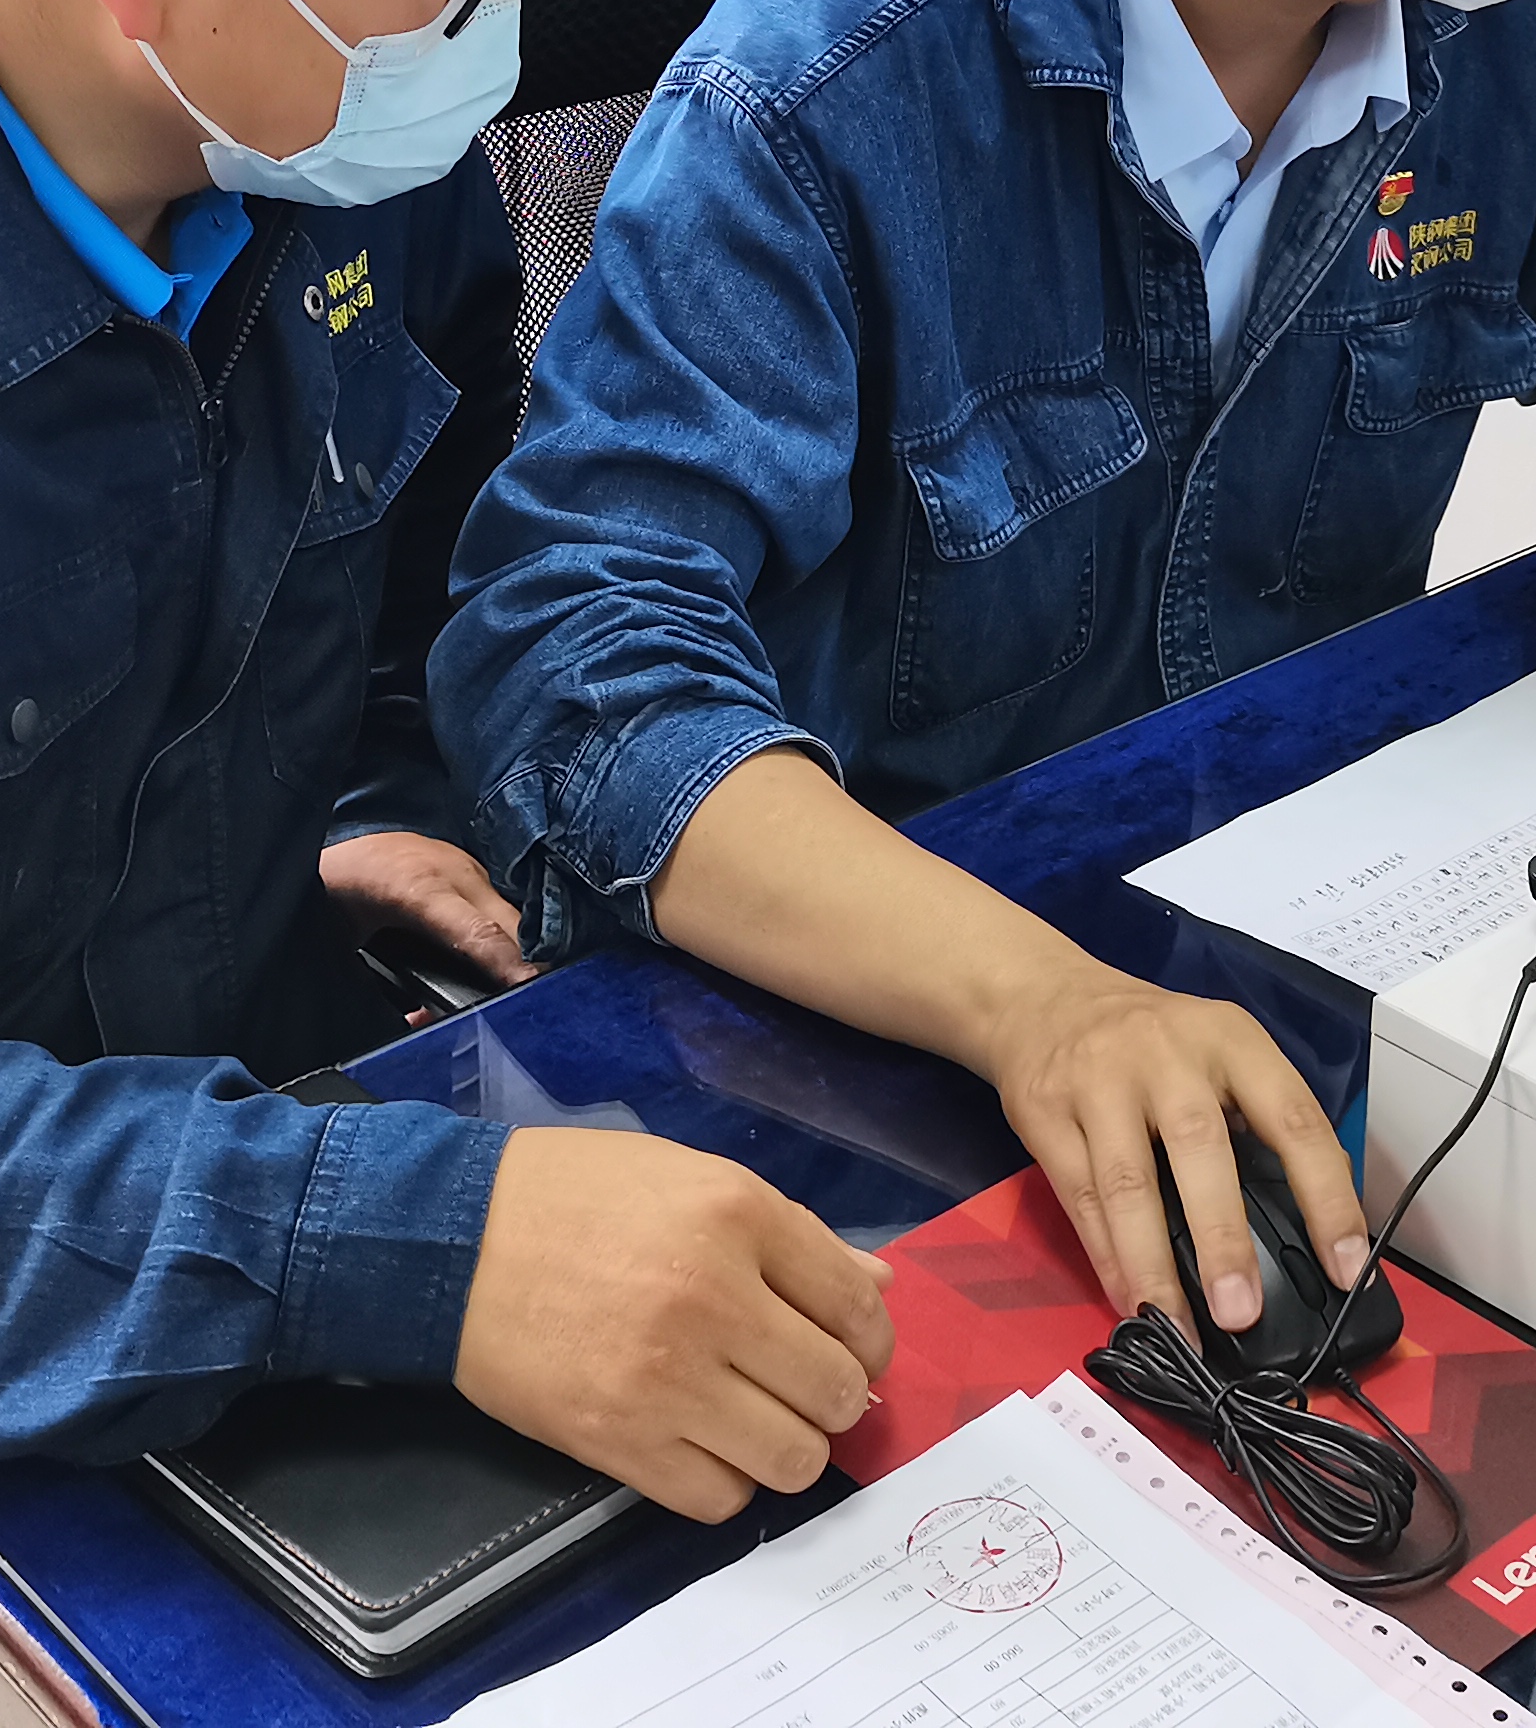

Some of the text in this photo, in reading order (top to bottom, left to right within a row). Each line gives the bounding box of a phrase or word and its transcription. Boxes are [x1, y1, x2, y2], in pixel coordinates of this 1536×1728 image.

[911, 1617, 958, 1655] 2065.00
[1070, 1621, 1121, 1662] 四轮定位
[981, 1641, 1023, 1675] 560.00
[881, 1700, 929, 1728] 配件小
